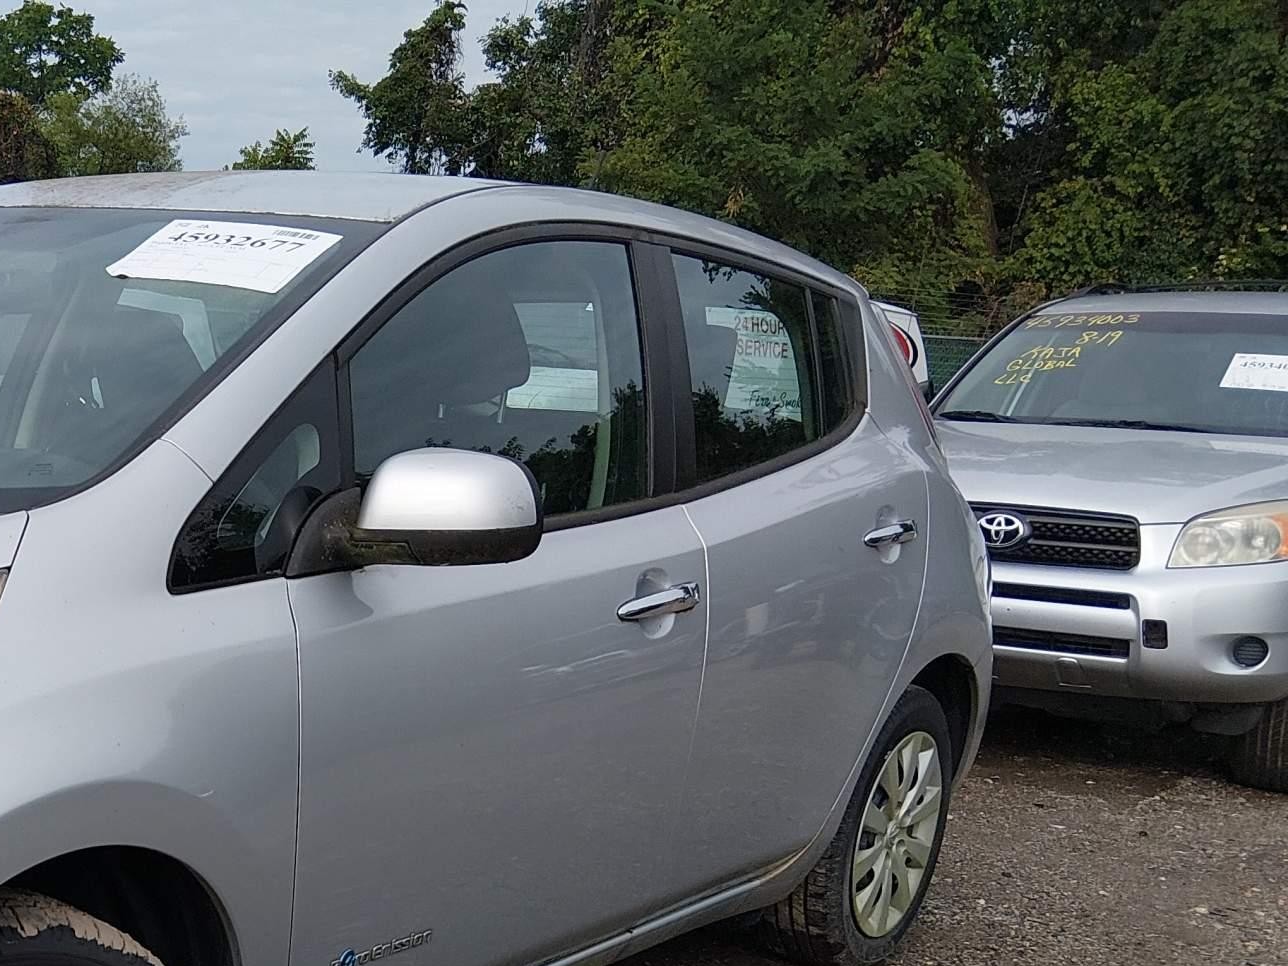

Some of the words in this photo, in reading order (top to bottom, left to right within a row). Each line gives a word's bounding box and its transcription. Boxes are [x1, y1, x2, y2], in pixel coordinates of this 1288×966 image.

[168, 231, 305, 253] 45932677
[734, 315, 749, 331] 24
[752, 316, 786, 335] HOUR
[1075, 330, 1123, 346] 8-19
[736, 339, 789, 359] SERVICE
[1006, 358, 1076, 371] GLOBAL
